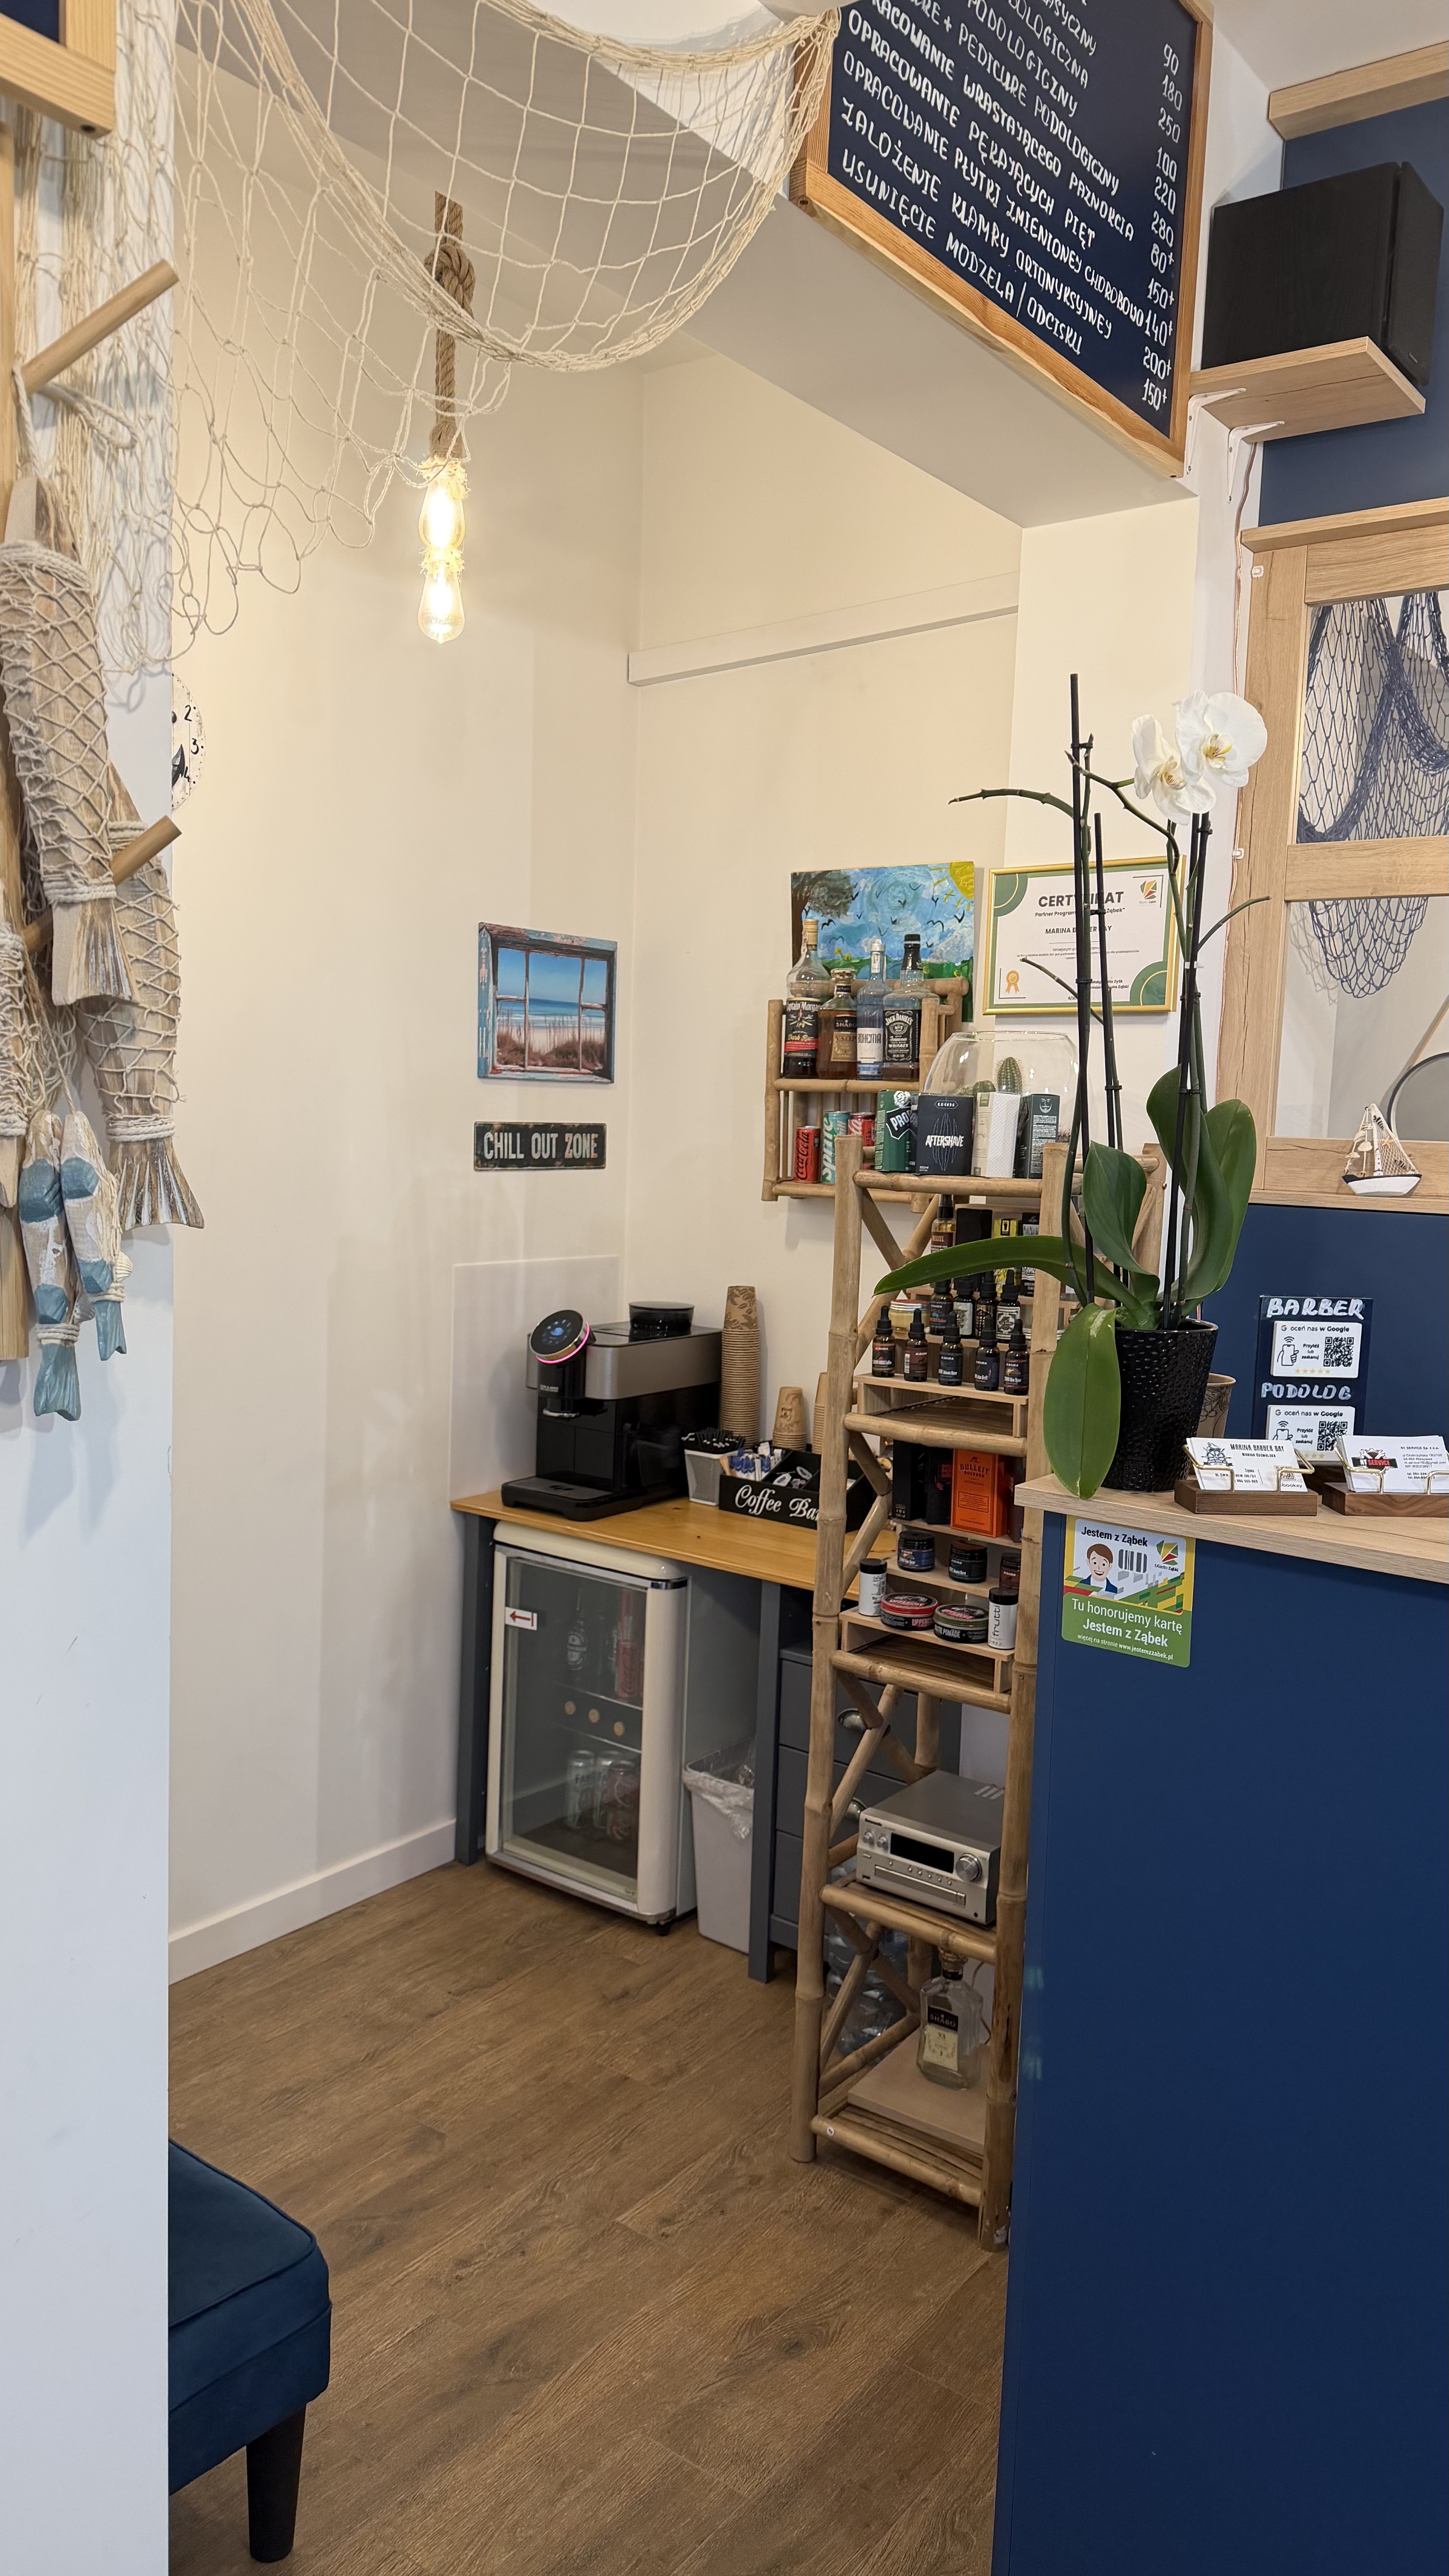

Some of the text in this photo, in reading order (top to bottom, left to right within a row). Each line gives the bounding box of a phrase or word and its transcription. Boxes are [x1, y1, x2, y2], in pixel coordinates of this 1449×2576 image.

[1164, 43, 1179, 75] 90
[1162, 74, 1182, 111] 180
[849, 9, 960, 128] OPRACOWANIE
[1064, 208, 1095, 250] PIĘT
[959, 23, 1027, 106] PEDICURE
[1035, 95, 1119, 196] PODOLOGICZNY
[1151, 211, 1174, 247] 280
[1158, 107, 1180, 143] 250
[1156, 147, 1177, 182] 100
[843, 51, 949, 161] OPRACOWANIE
[954, 147, 1001, 207] PŁYTKI
[1085, 266, 1144, 327] CHOROBOWO
[1154, 176, 1176, 215] 220
[1069, 172, 1134, 241] PAZNOKCIA
[952, 192, 1009, 258] KLAMRY
[842, 149, 936, 239] USUNIĘCIE
[946, 231, 1014, 304] MODZELA
[1027, 297, 1083, 355] ODCISKU
[184, 704, 193, 722] 2
[191, 738, 199, 755] 3
[484, 1132, 598, 1159] CHILL OUT ZONE
[925, 1135, 964, 1148] AFTERSHAVE
[1266, 1298, 1365, 1320] BARBER
[1261, 1382, 1352, 1400] PODOLOG
[960, 1463, 989, 1474] BULLEIT
[735, 1484, 782, 1515] Coffee
[1081, 1527, 1112, 1541] Jestem
[1122, 1534, 1148, 1547] Ząbek
[992, 1605, 1000, 1637] frutti
[1072, 1598, 1182, 1635] Tu honorujemy kartę
[1083, 1618, 1168, 1647] Jestem z Ząbek
[943, 1628, 961, 1638] POMADE
[1077, 1633, 1093, 1642] więcej
[1101, 1639, 1118, 1647] stronie
